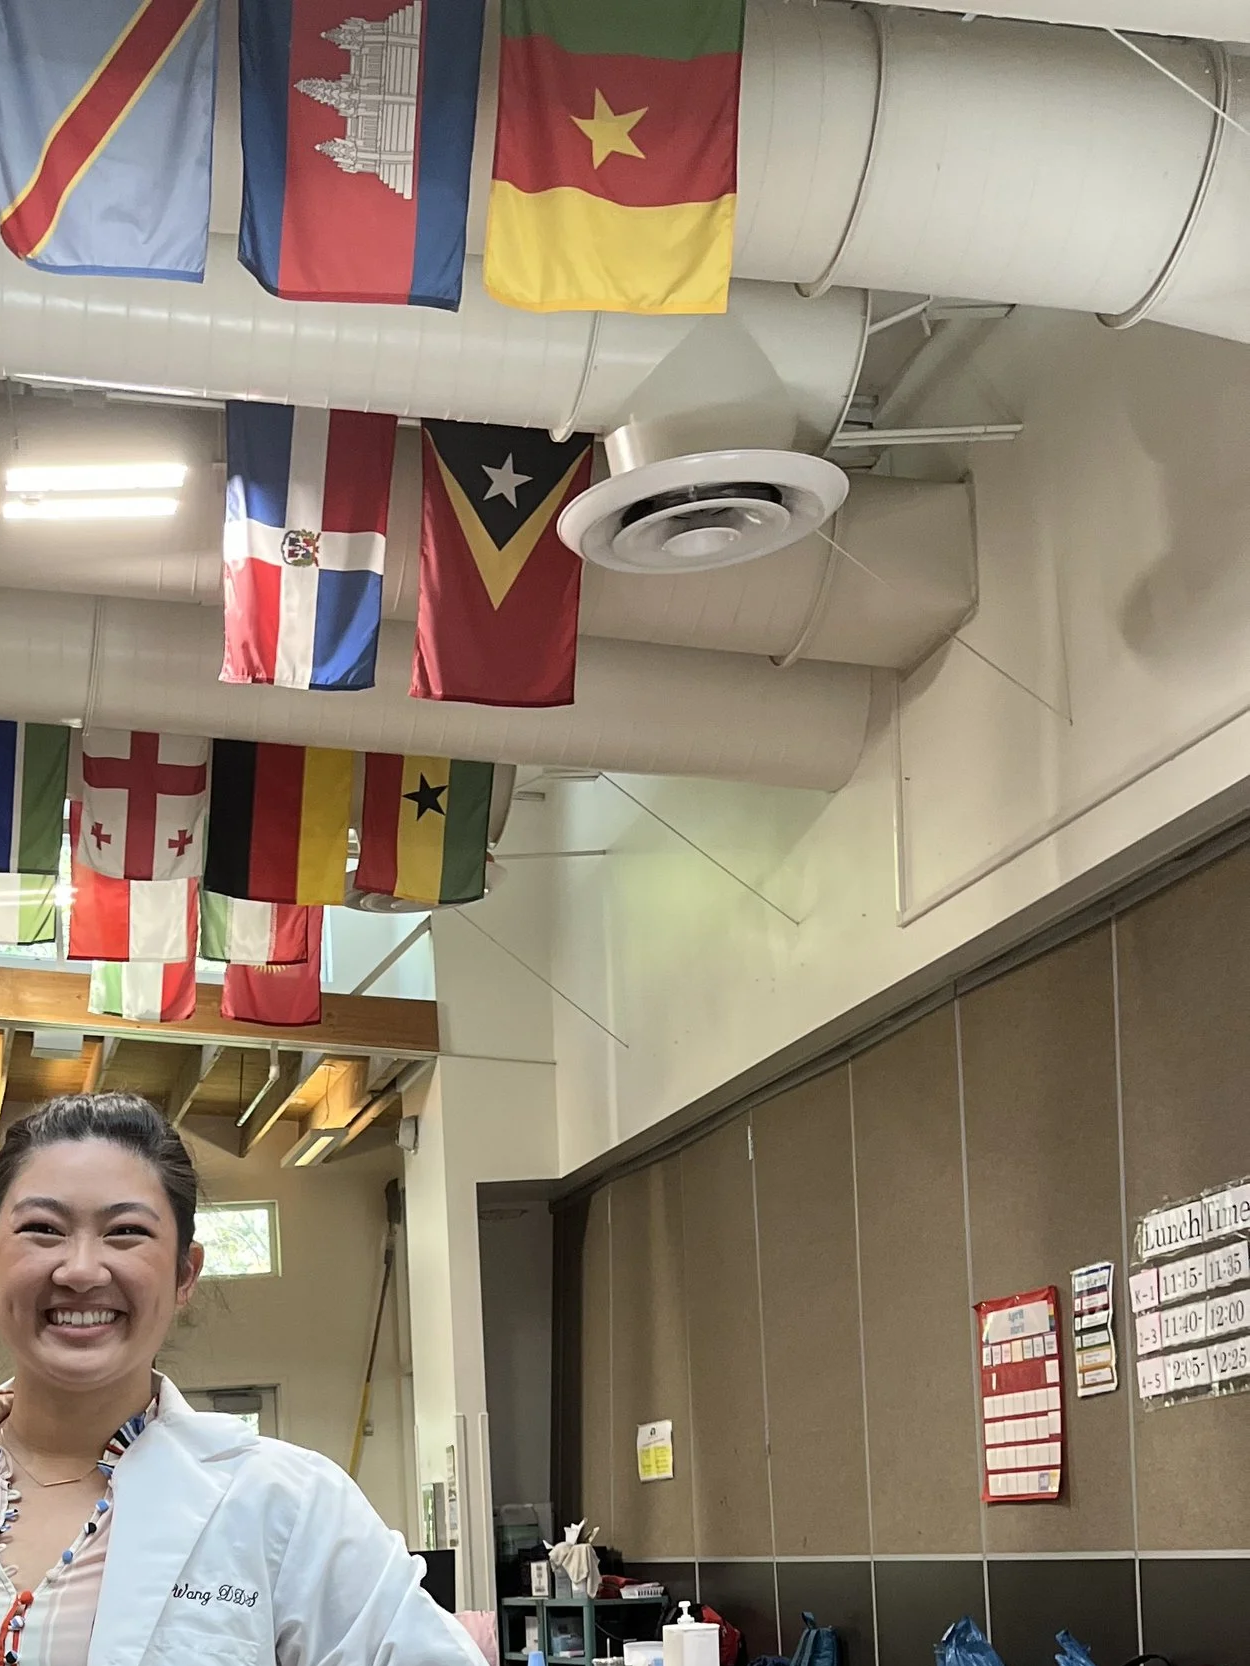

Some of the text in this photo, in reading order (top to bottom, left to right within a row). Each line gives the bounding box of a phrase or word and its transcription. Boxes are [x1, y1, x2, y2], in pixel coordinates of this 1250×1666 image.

[1143, 1209, 1202, 1252] Lunch
[1210, 1253, 1242, 1283] 11:35
[1210, 1300, 1245, 1330] 12:00
[1167, 1357, 1205, 1381] 2:05-
[1213, 1346, 1248, 1373] 12:25
